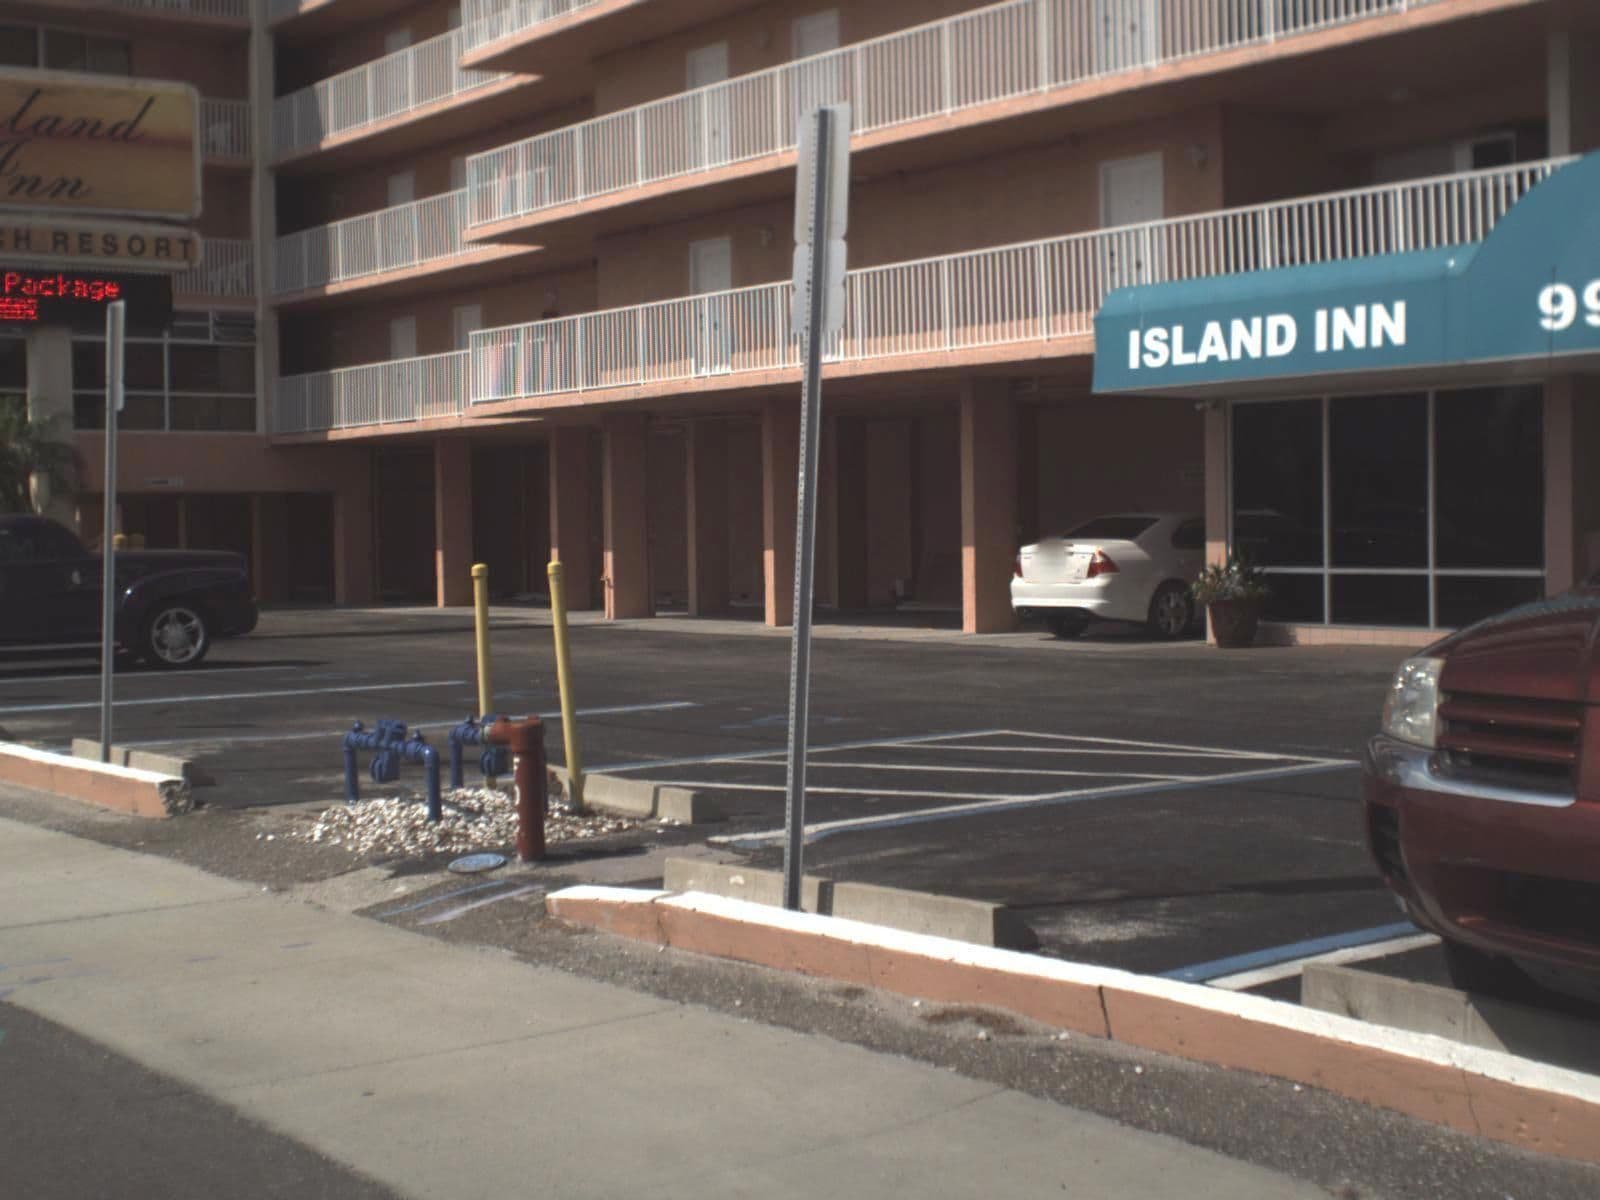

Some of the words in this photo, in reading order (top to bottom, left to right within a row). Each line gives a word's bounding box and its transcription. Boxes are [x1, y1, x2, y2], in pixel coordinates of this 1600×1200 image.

[0, 226, 32, 251] H
[53, 230, 193, 260] RESORT
[4, 272, 120, 301] Package
[1127, 313, 1297, 370] ISLAND
[1314, 300, 1407, 352] INN
